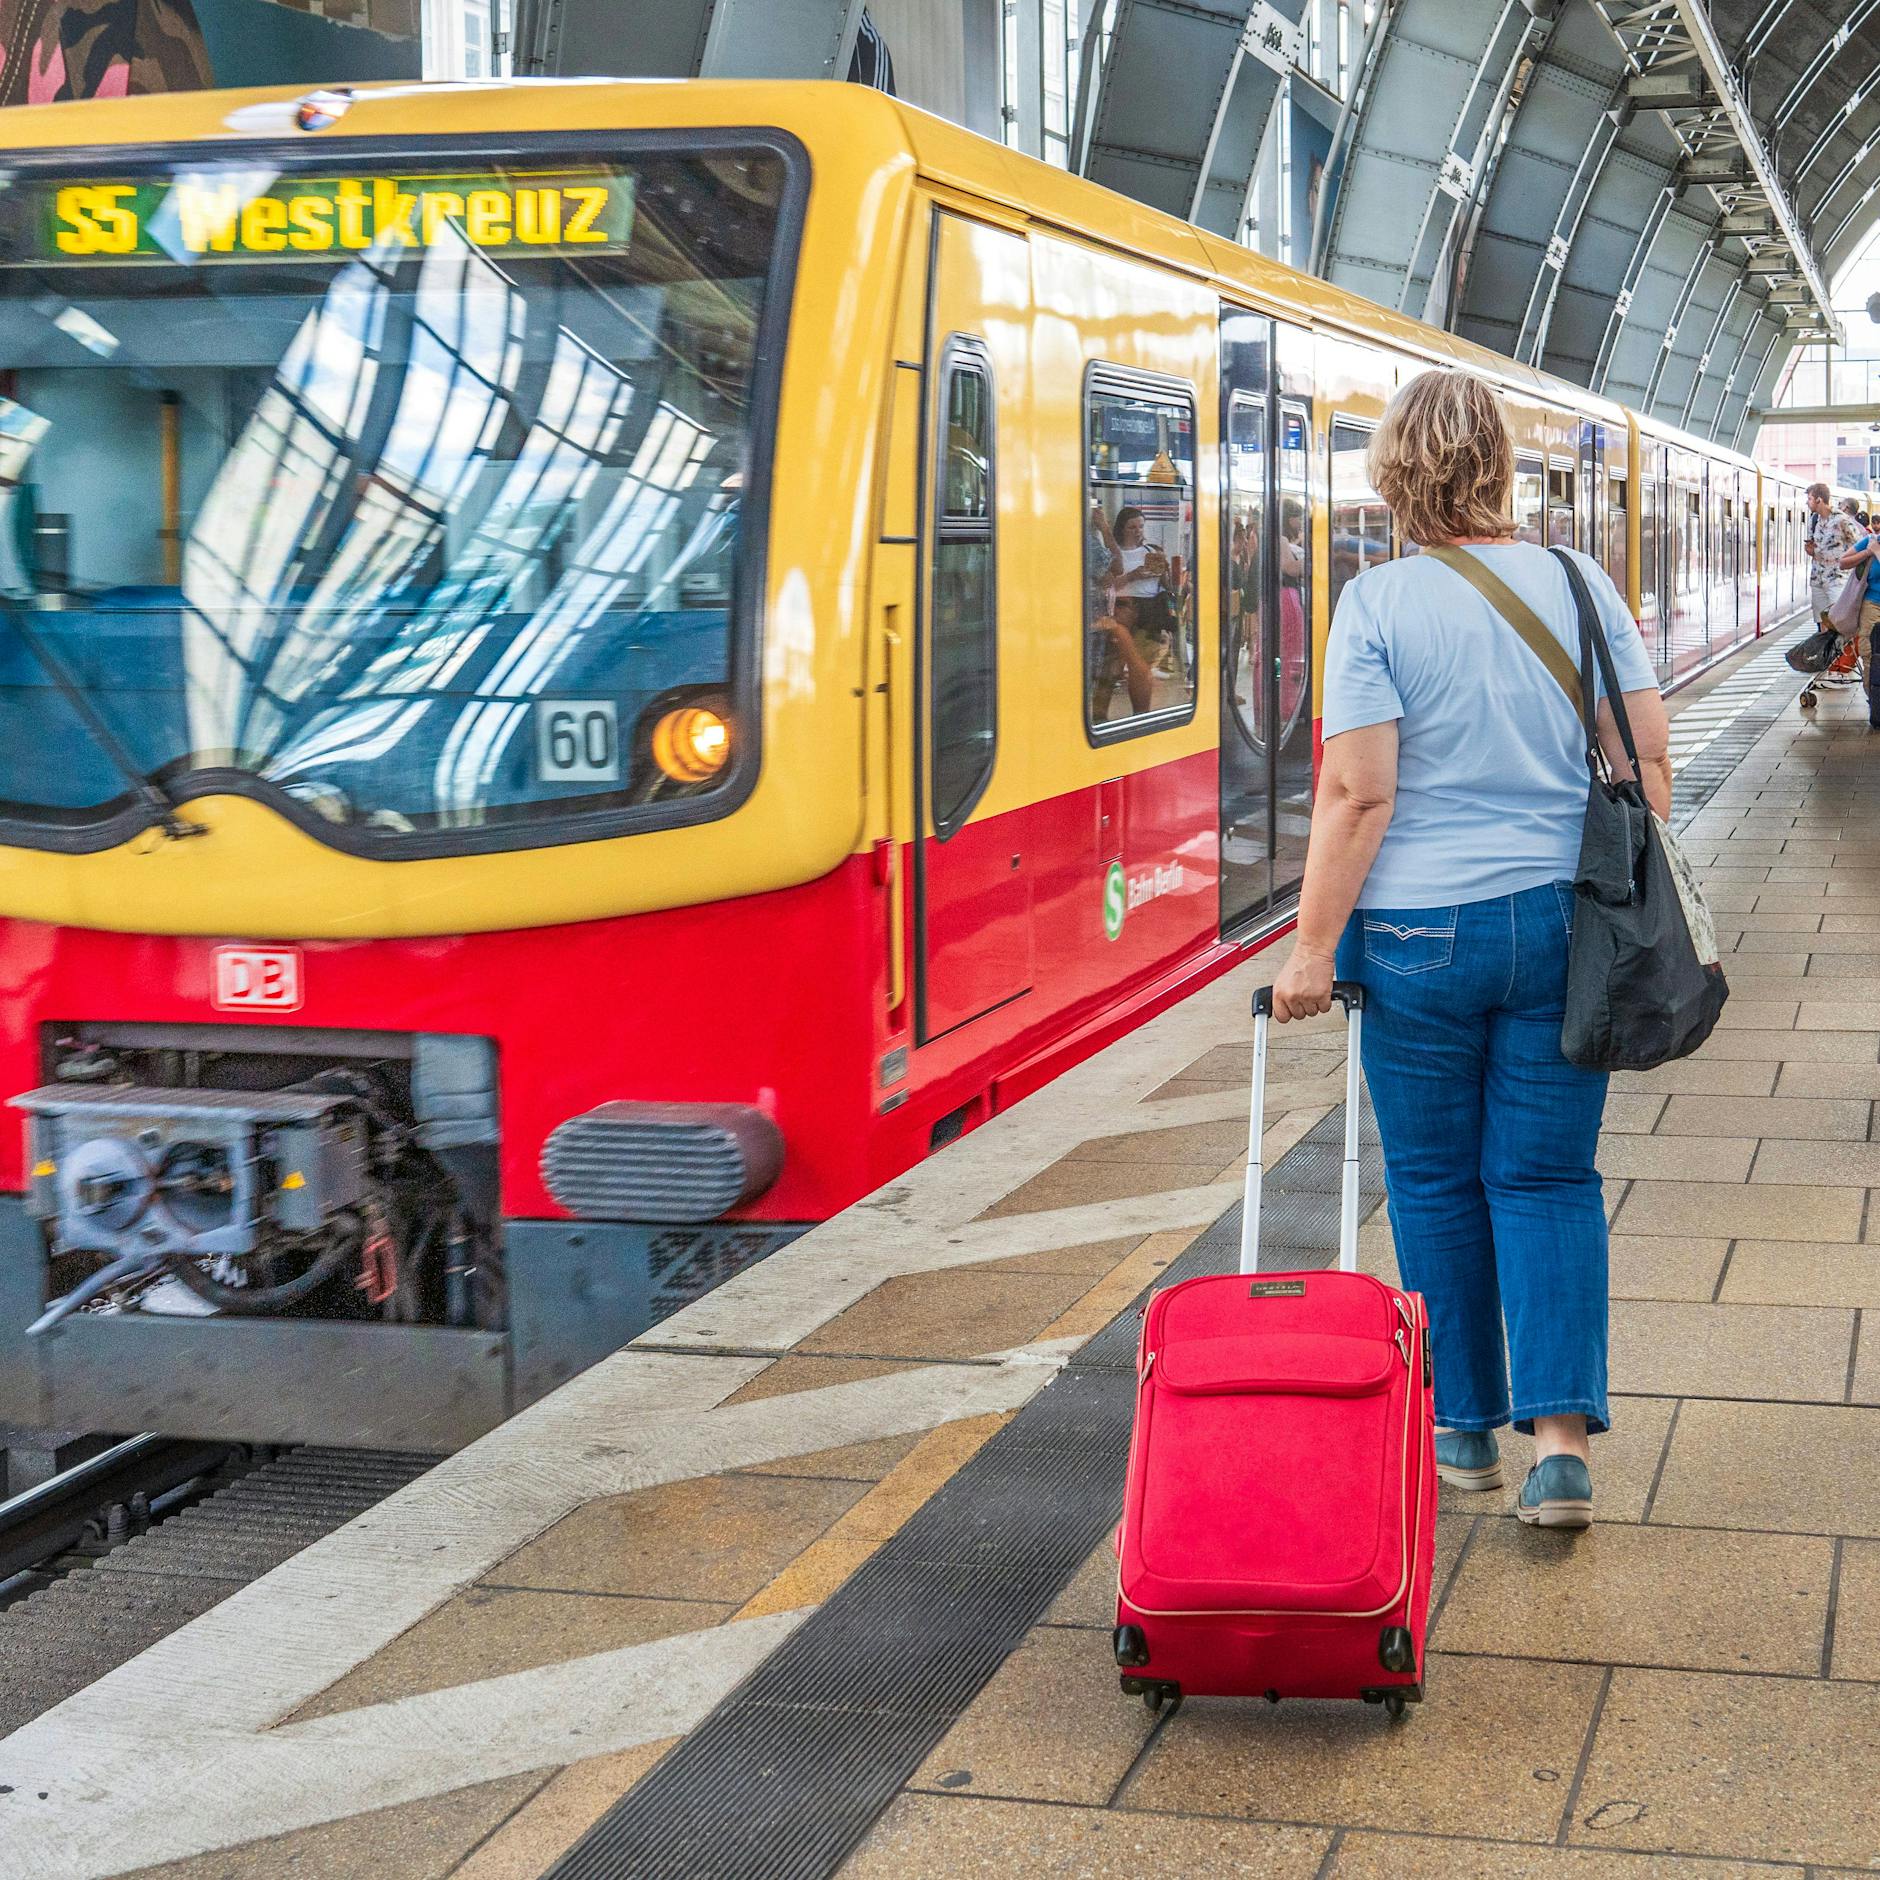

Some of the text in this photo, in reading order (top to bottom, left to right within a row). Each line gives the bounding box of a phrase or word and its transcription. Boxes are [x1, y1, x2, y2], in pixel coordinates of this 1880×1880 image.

[56, 177, 609, 254] S5 Westkreuz
[551, 710, 609, 769] 60
[225, 958, 288, 999] DB
